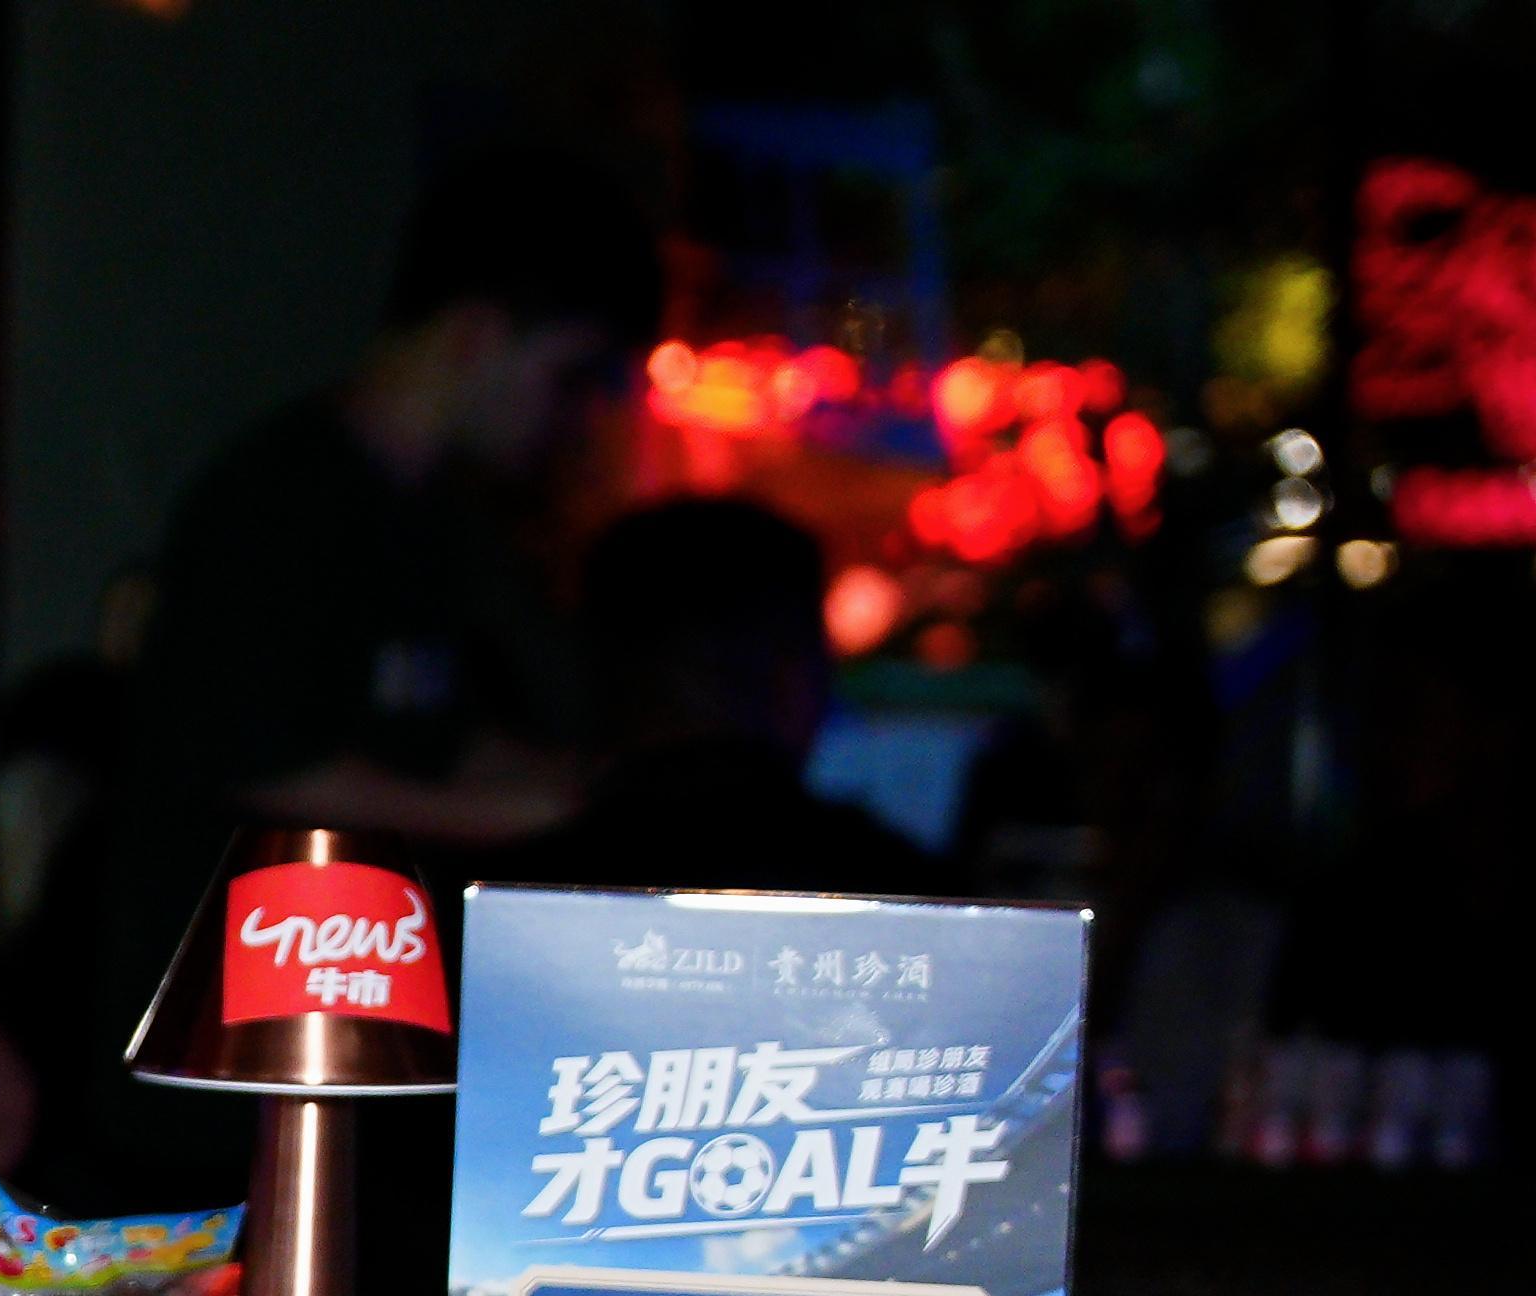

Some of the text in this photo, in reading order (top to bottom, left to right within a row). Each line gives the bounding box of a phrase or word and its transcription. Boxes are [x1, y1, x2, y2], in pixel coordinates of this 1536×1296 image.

[240, 887, 427, 967] news
[305, 965, 392, 1009] 牛市
[768, 943, 932, 990] 贵州珍酒
[539, 1040, 848, 1137] 珍朋友
